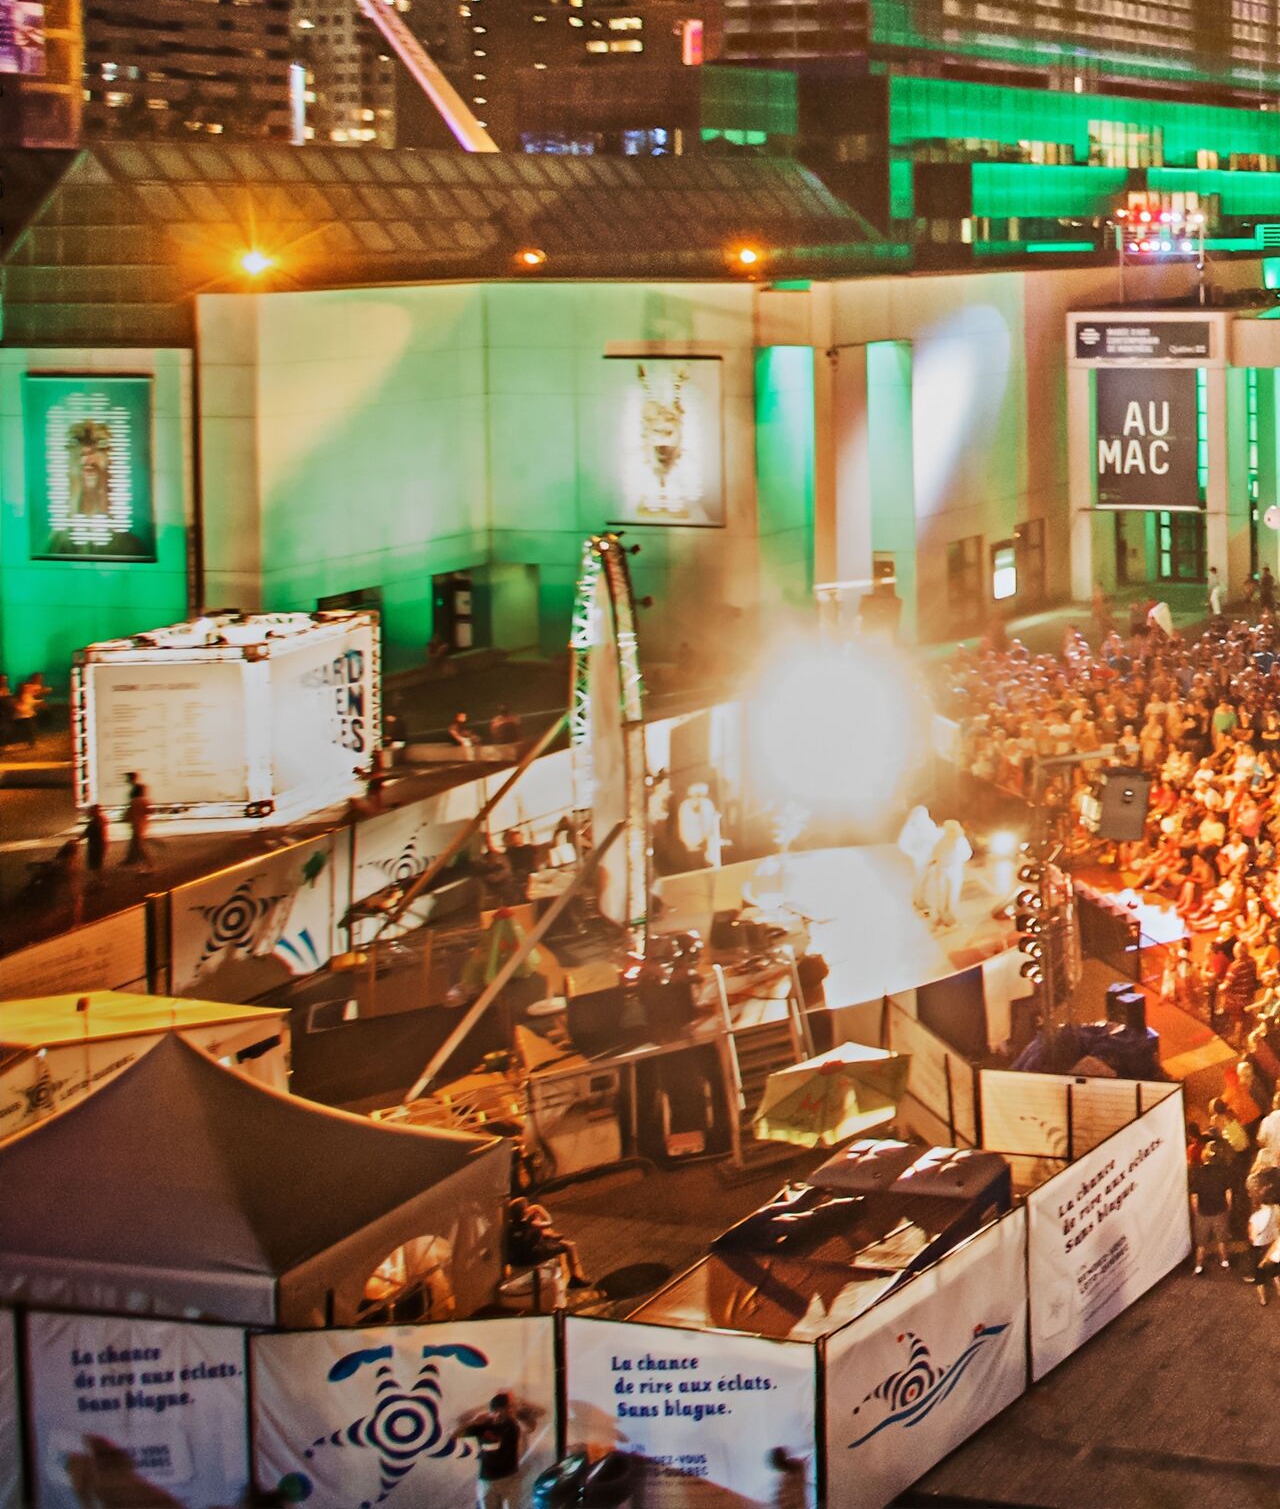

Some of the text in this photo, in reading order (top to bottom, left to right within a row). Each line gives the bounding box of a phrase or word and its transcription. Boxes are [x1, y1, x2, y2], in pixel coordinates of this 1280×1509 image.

[1123, 400, 1169, 437] AU
[1098, 439, 1169, 475] MAC
[1057, 1159, 1115, 1219] La chance
[1062, 1216, 1077, 1236] de
[1079, 1196, 1102, 1222] rire
[1105, 1171, 1126, 1196] aux
[1064, 1222, 1094, 1255] Sans
[71, 1344, 161, 1366] La chance
[610, 1353, 700, 1372] La chance
[73, 1361, 243, 1389] de rire aux éclats.
[614, 1373, 778, 1394] de rire aux éclats.
[77, 1390, 195, 1413] Sans blague.
[617, 1399, 732, 1421] Sans blague.
